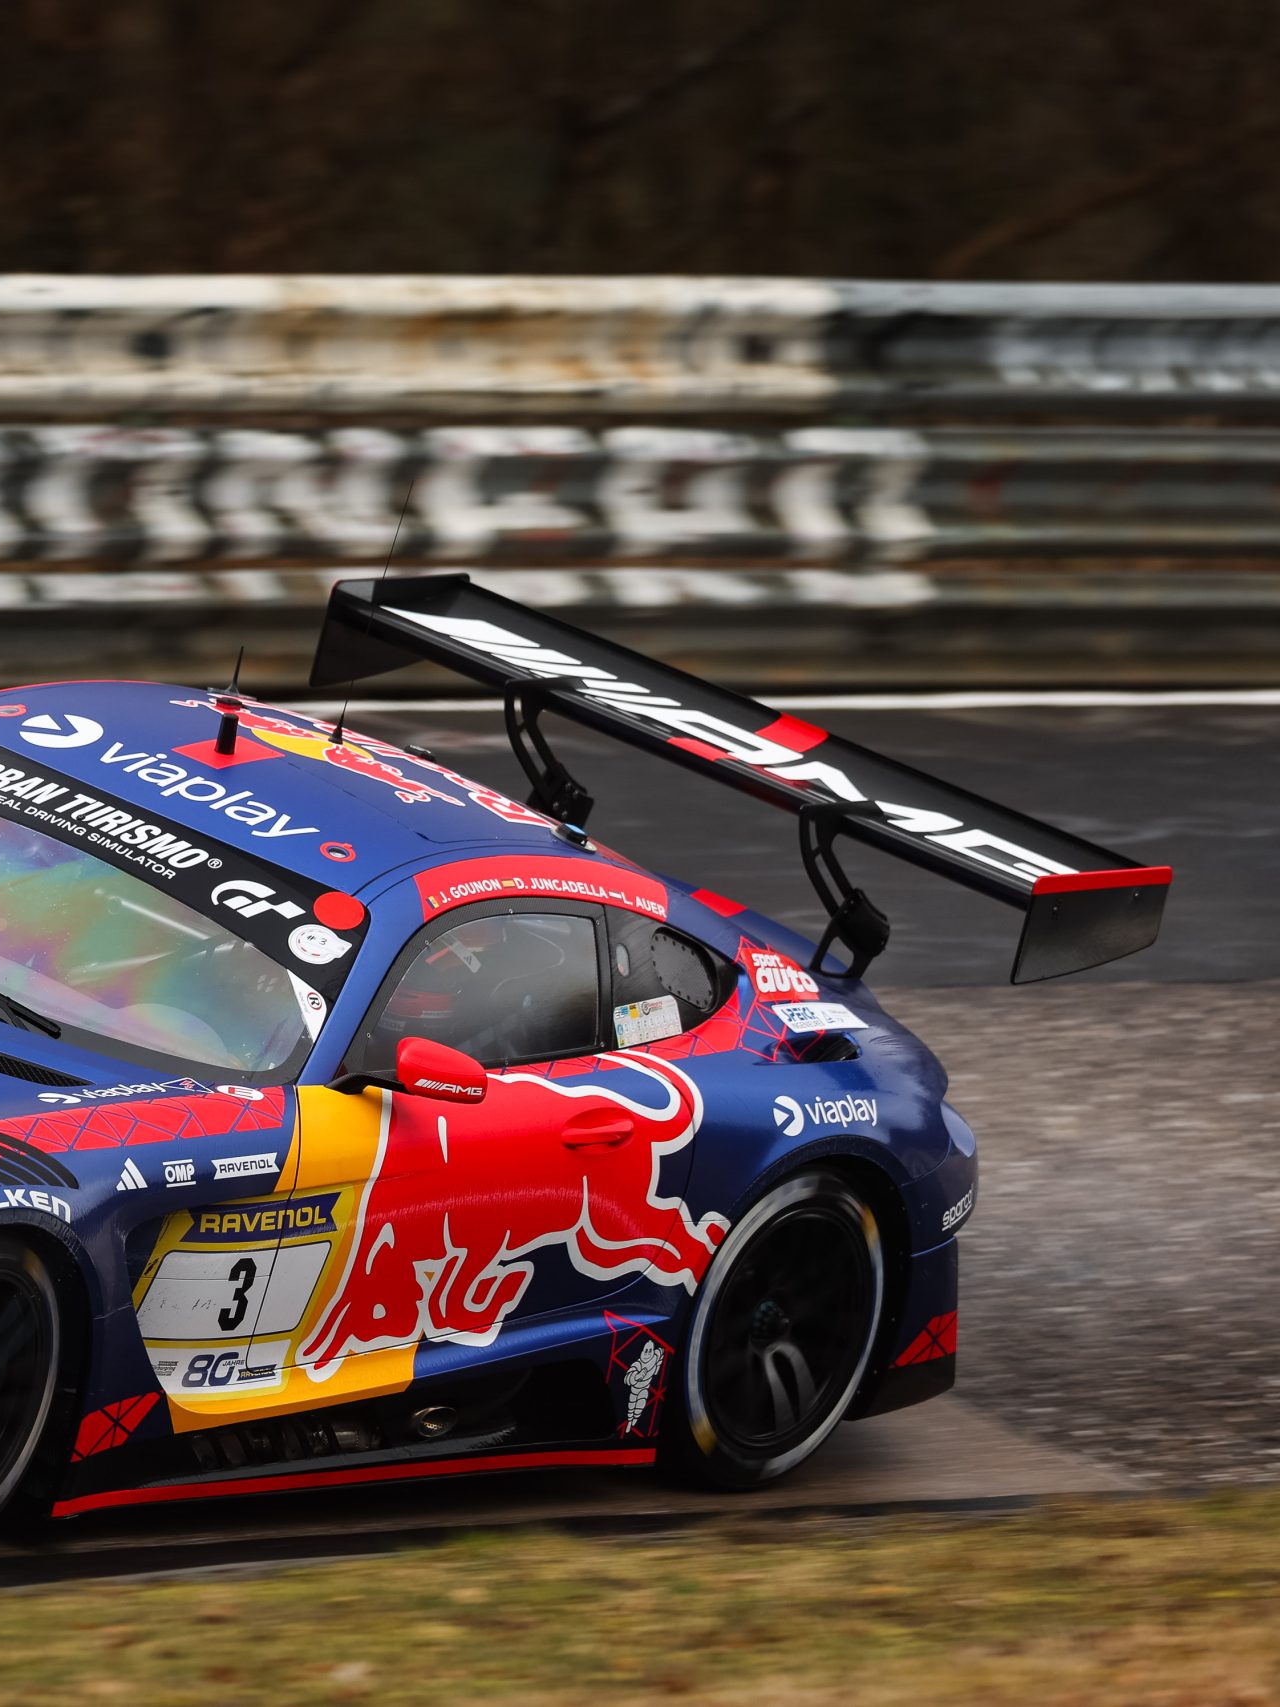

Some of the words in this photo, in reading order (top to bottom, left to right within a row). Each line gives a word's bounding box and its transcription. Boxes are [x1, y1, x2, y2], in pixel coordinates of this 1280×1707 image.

[100, 741, 320, 838] viaplay
[24, 806, 84, 837] DRIVING
[87, 832, 177, 880] SIMULATOR
[54, 793, 210, 869] TURISMO
[441, 891, 450, 904] J.
[450, 879, 502, 900] GOUNON
[514, 877, 528, 890] D.
[531, 878, 609, 899] JUNCADELLA
[621, 893, 633, 906] L.
[636, 896, 668, 918] AUER
[752, 953, 783, 968] sport
[755, 966, 819, 993] auto
[72, 1081, 167, 1099] viaplay
[440, 1083, 483, 1096] AMG
[804, 1094, 878, 1128] viaplay
[164, 1164, 195, 1183] OMP
[219, 1159, 273, 1174] RAVENOL
[199, 1205, 327, 1233] RAVENOL
[218, 1257, 257, 1331] 3
[181, 1351, 240, 1388] 80
